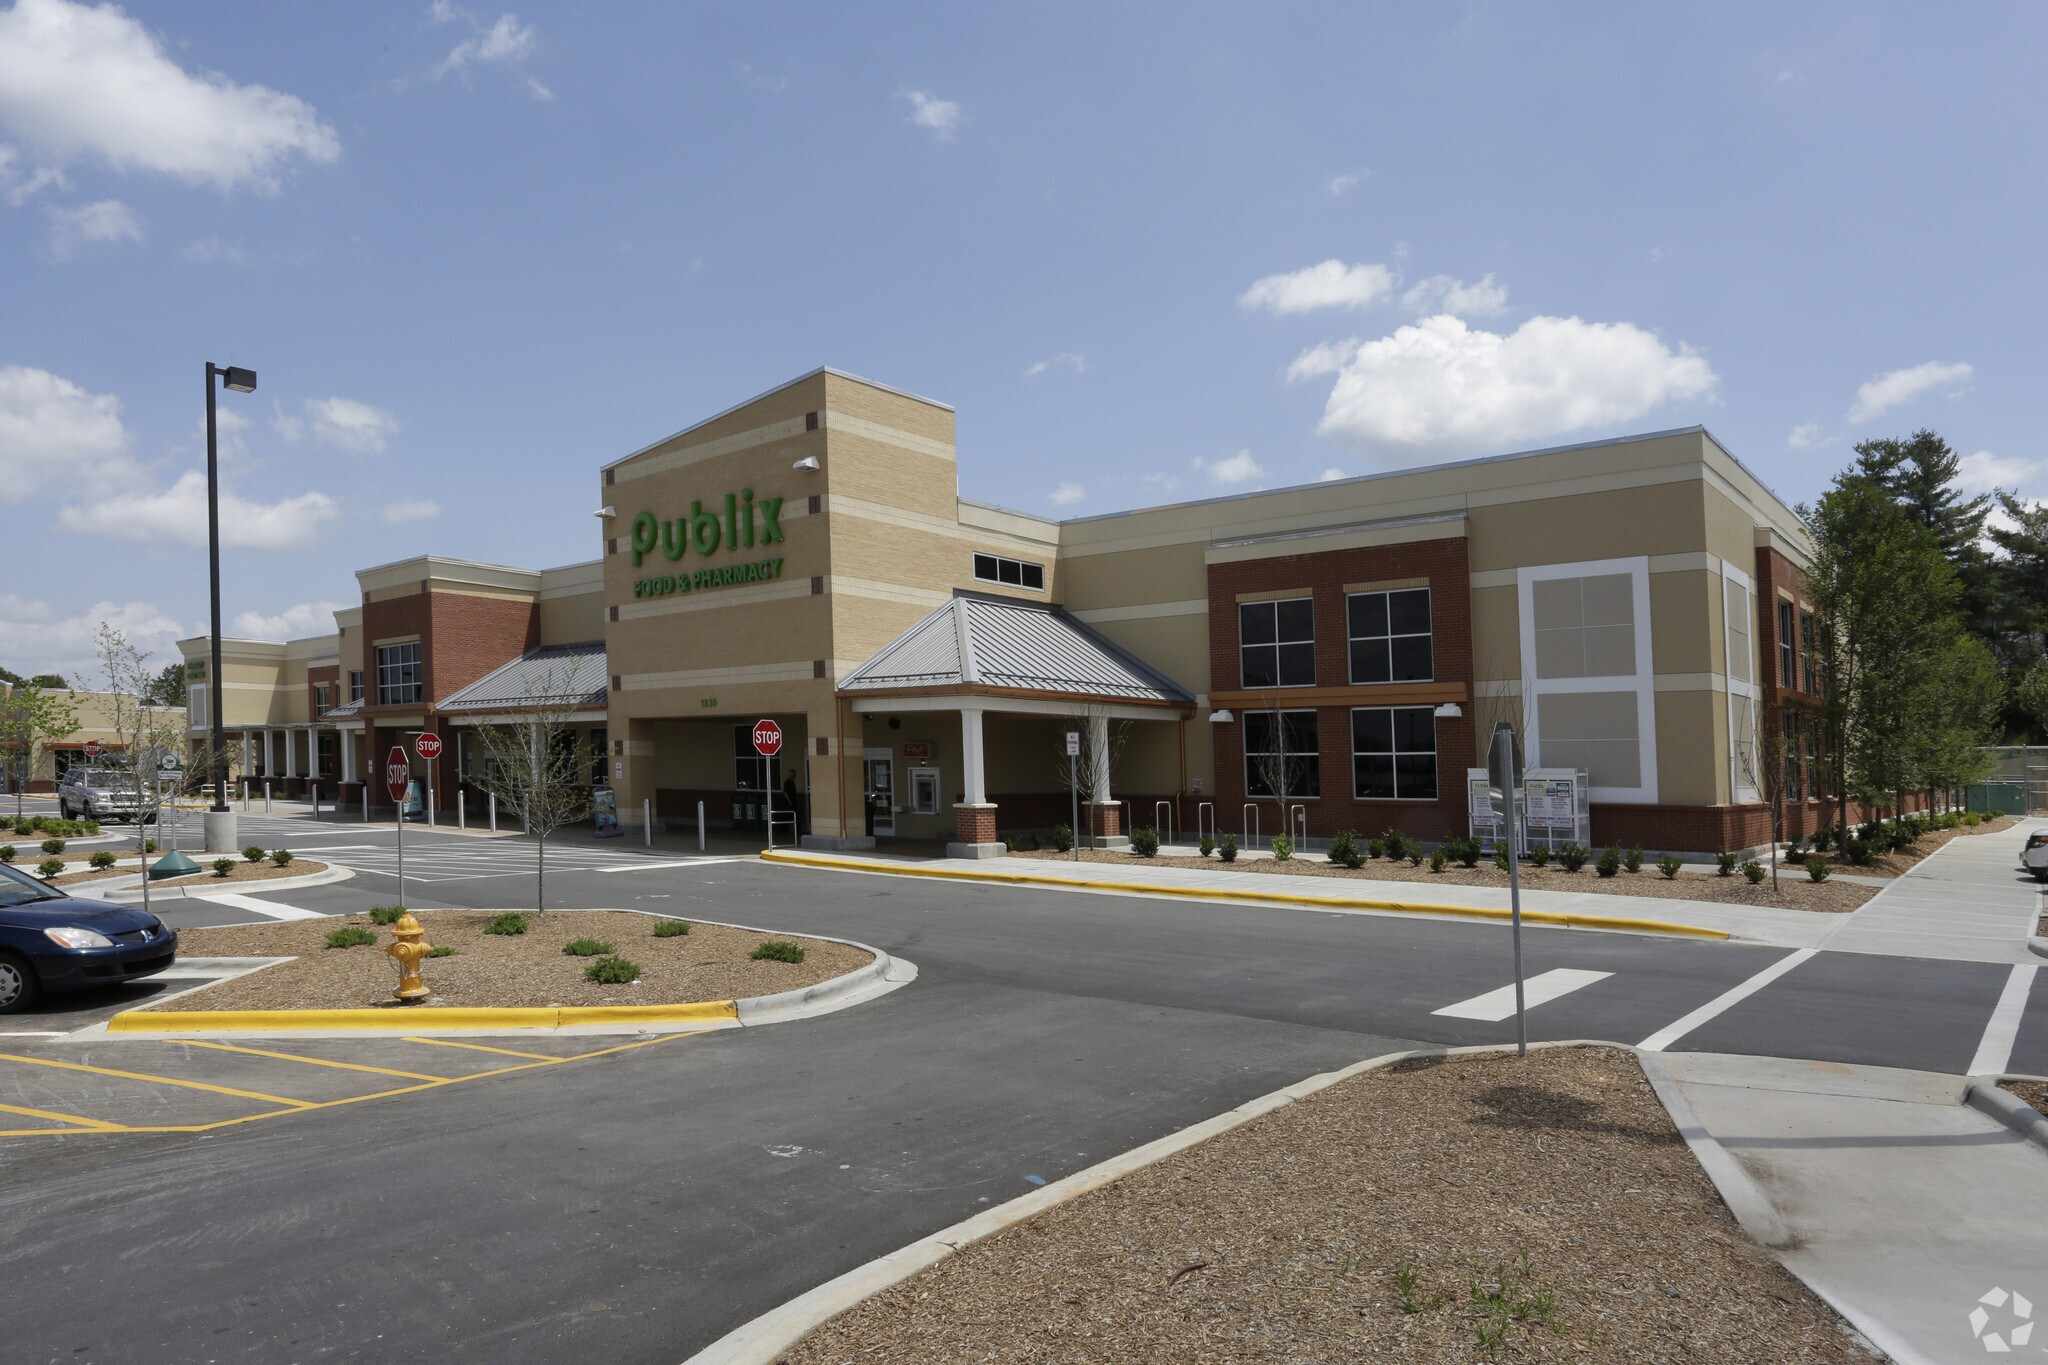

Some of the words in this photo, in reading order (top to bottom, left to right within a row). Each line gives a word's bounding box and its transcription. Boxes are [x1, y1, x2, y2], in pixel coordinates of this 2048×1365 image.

[631, 487, 783, 567] Publix
[634, 576, 676, 597] FOOD
[678, 574, 691, 592] &
[692, 558, 784, 588] PHARMACY
[700, 698, 718, 708] 1830
[756, 731, 780, 744] STOP
[418, 741, 440, 751] STOP
[389, 764, 407, 784] STOP
